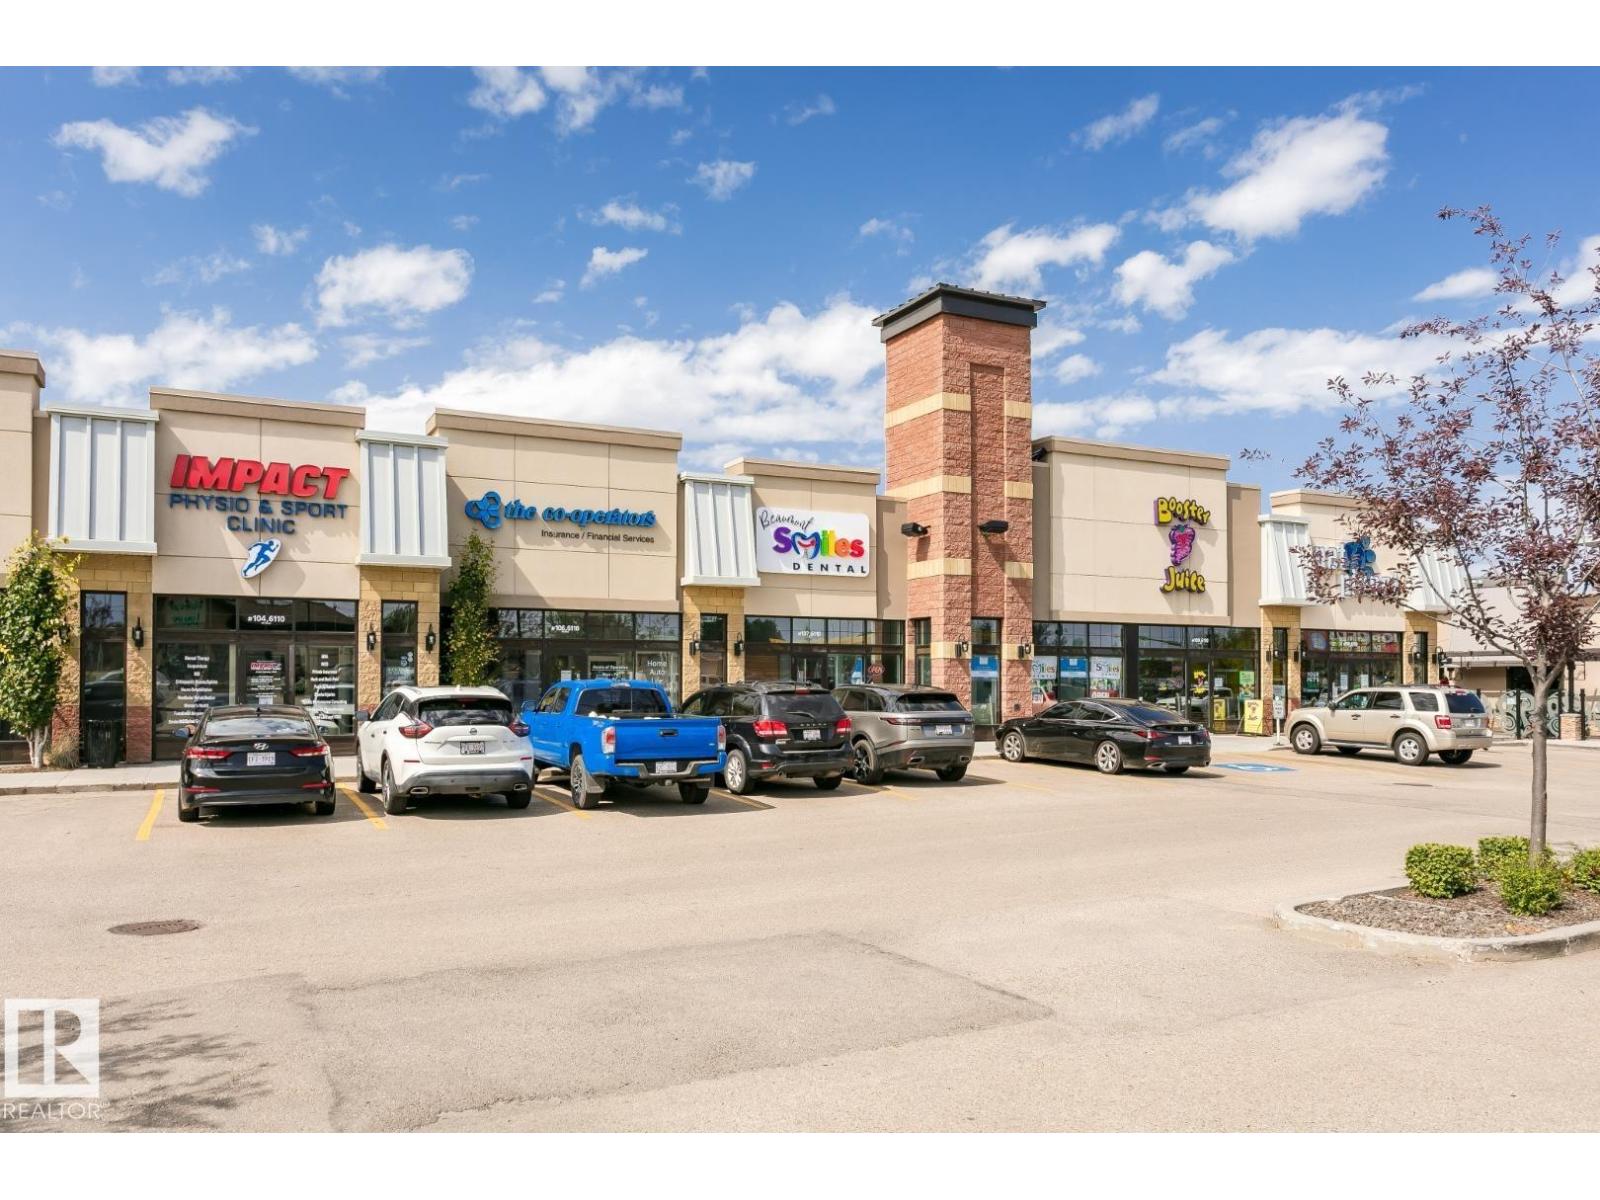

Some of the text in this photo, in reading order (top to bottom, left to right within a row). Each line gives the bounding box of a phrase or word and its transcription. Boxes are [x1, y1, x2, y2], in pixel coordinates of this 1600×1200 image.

[170, 454, 350, 500] IMPACT
[170, 493, 349, 519] PHYSIO & SPORT
[504, 499, 656, 528] the co-operators
[1154, 497, 1210, 525] Booster
[226, 516, 296, 535] CLINIC
[758, 509, 814, 531] Beaumont
[541, 529, 580, 540] Insurance
[587, 532, 621, 542] Financial
[622, 534, 655, 543] Services
[772, 526, 865, 559] Smiles
[793, 562, 866, 574] DENTAL
[1160, 566, 1205, 593] Juice
